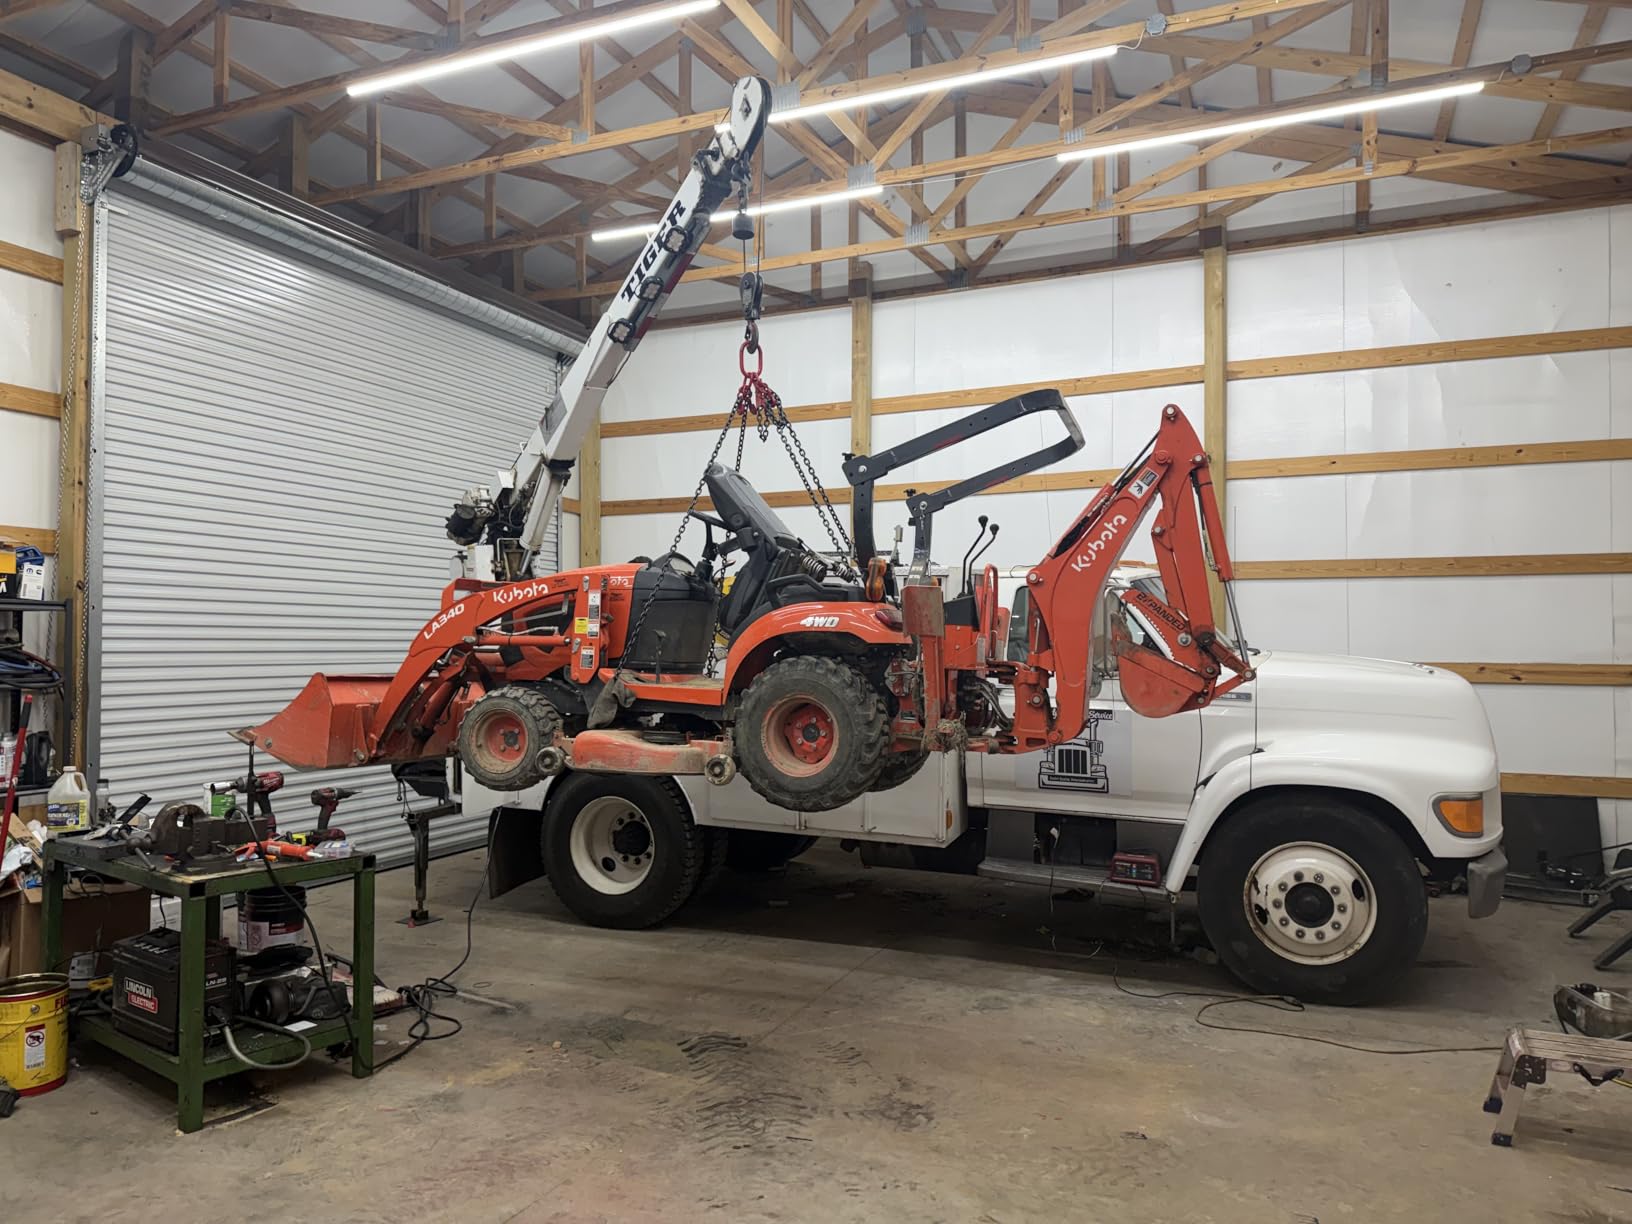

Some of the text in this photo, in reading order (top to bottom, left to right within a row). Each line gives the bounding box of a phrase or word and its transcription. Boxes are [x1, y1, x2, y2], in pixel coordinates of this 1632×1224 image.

[1071, 514, 1127, 572] Kubota
[493, 582, 549, 604] Kubota
[423, 603, 465, 640] LA340
[800, 616, 839, 628] 4WD
[1089, 710, 1113, 720] Service
[125, 980, 152, 999] LINCOLN
[131, 994, 155, 1010] ELECTRIC
